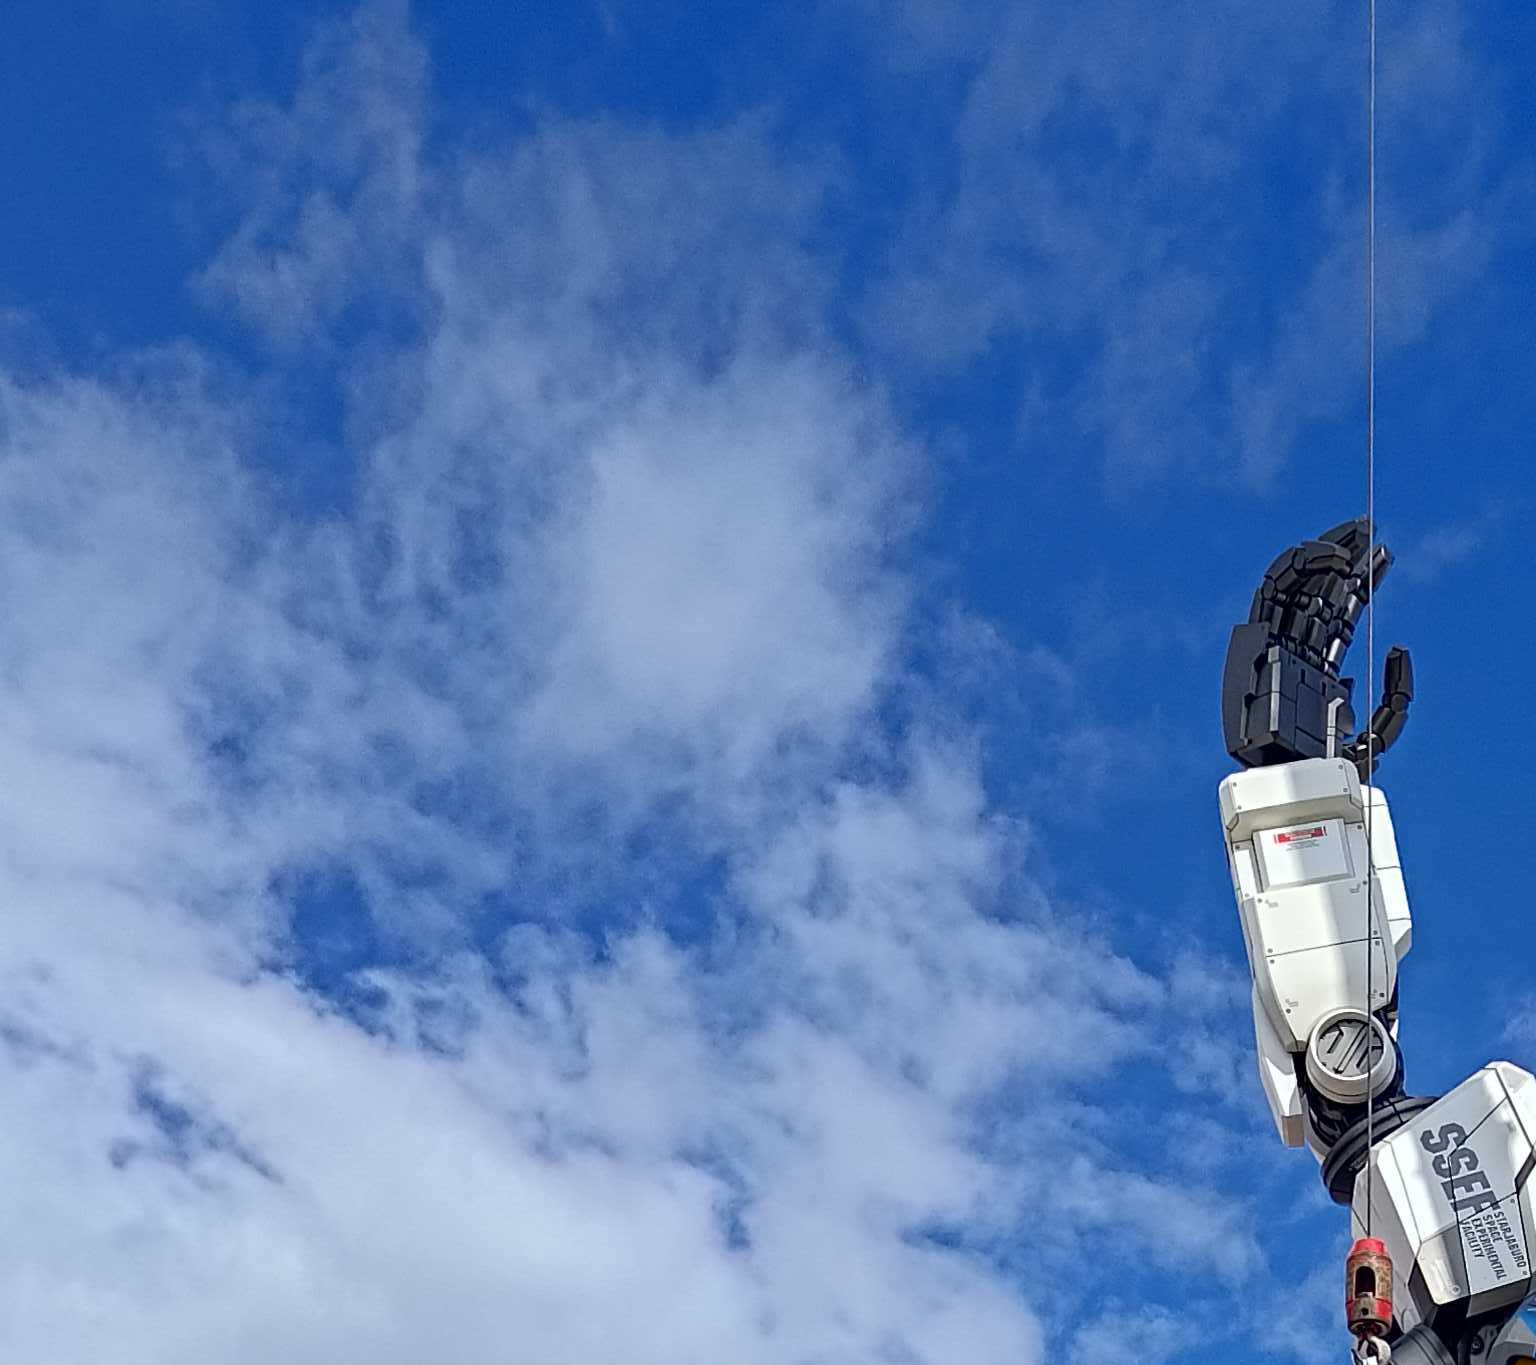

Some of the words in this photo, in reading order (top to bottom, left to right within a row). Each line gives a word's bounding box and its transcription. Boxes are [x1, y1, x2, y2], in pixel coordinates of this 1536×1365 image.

[1420, 1122, 1501, 1211] SSEF
[1459, 1220, 1485, 1258] FACILITY
[1471, 1217, 1508, 1280] EXPERIMENTAL
[1482, 1214, 1503, 1243] SPACE
[1493, 1211, 1527, 1268] STARJABURO
